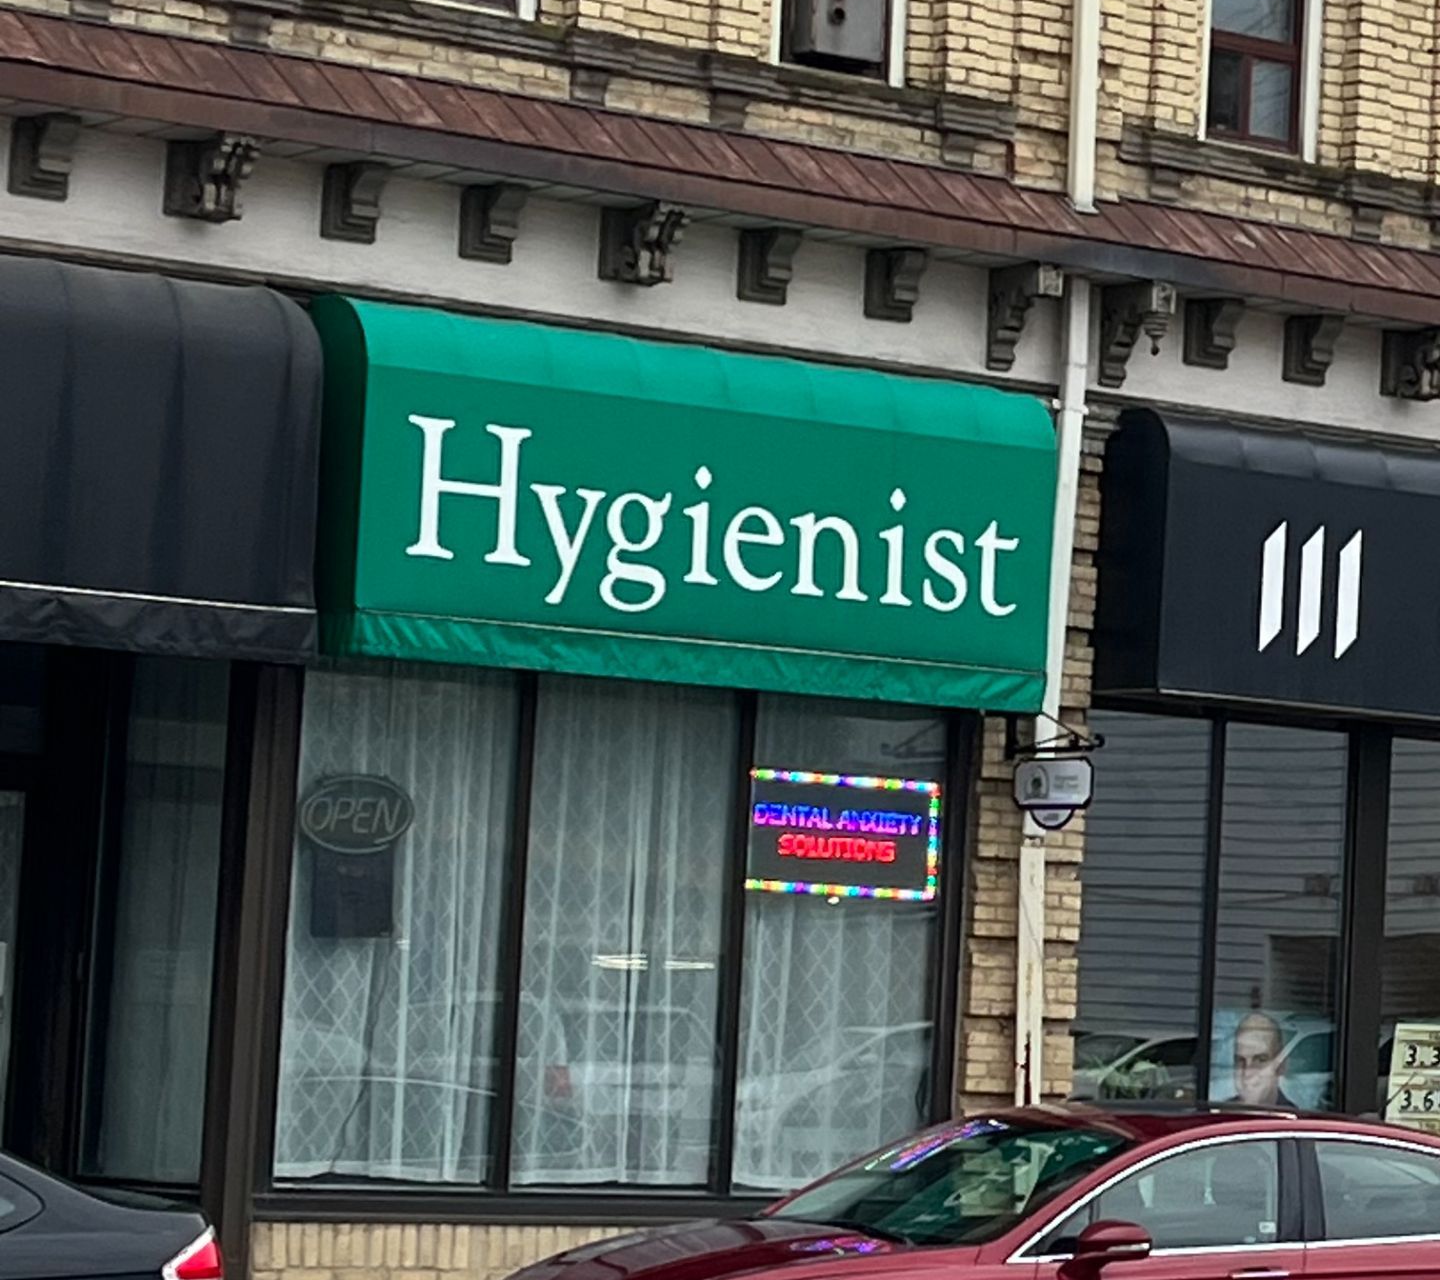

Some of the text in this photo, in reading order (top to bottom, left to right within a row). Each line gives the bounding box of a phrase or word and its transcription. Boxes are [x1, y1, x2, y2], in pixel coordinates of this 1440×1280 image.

[406, 414, 1019, 614] Hygienist
[307, 795, 402, 835] OPEN
[753, 802, 922, 836] DENTAL ANXIETY
[777, 833, 897, 863] SOLUTIONS
